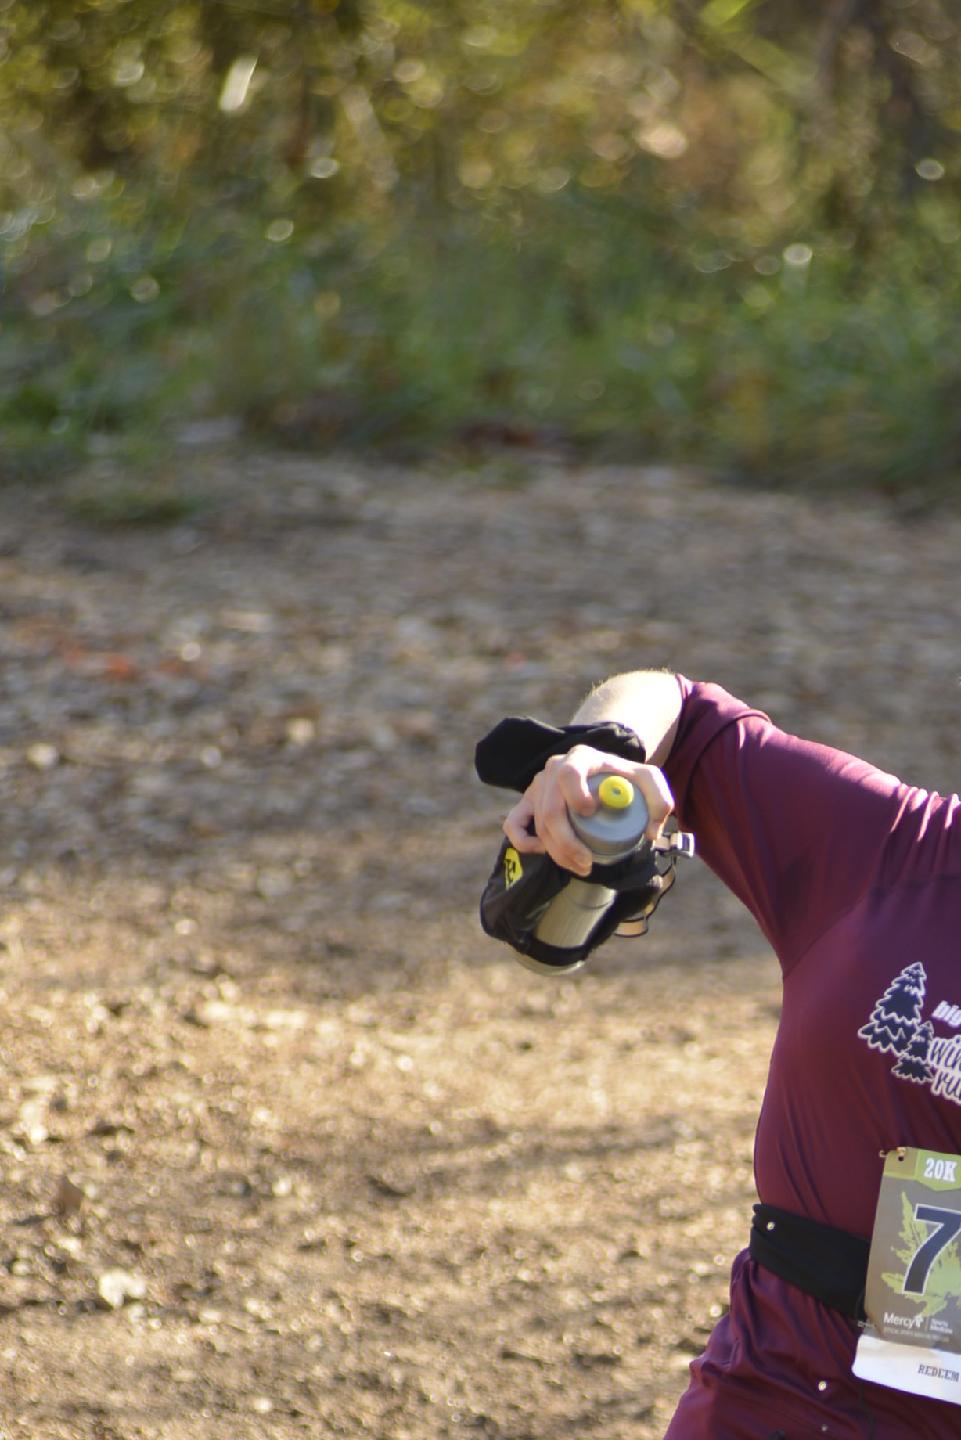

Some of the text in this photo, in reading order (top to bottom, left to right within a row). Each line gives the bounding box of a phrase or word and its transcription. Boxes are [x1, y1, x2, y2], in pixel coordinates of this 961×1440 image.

[923, 1157, 957, 1182] 20K
[883, 1312, 914, 1329] Mercy
[917, 1364, 960, 1382] REDEEM
